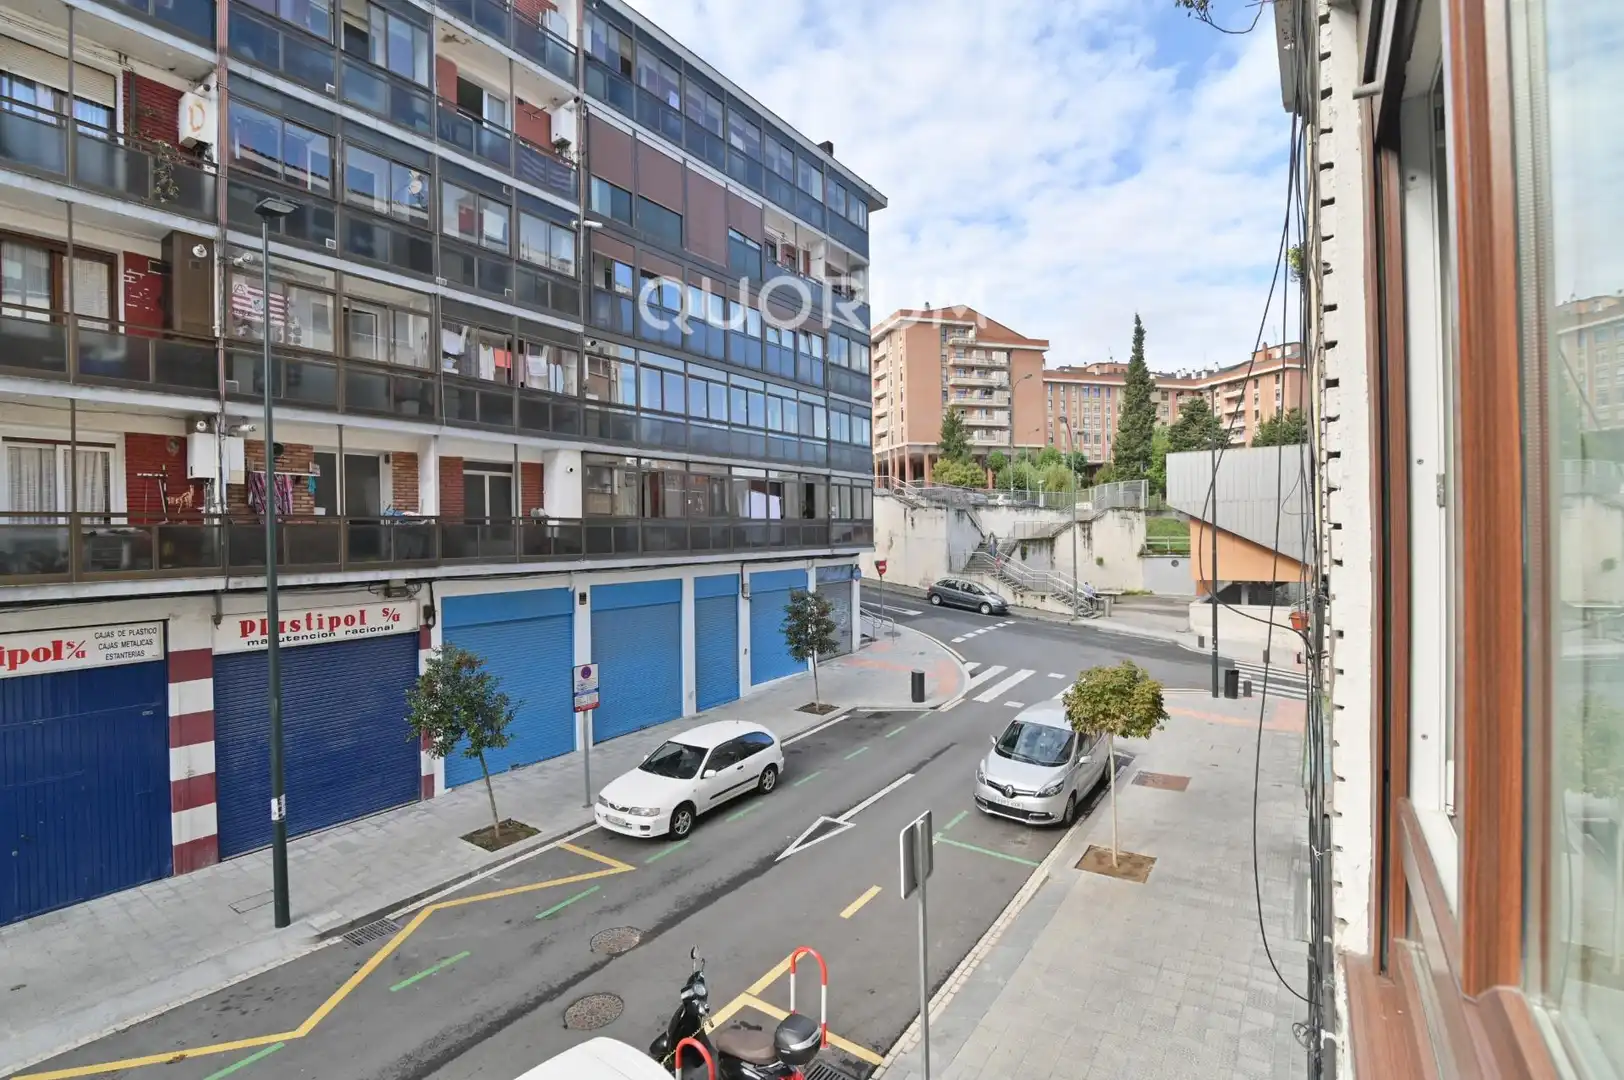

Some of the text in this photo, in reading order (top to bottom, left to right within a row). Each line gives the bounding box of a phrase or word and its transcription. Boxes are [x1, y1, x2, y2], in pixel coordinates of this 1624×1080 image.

[94, 627, 158, 639] CAJAS DE PLASTICO
[247, 624, 394, 646] mautencion racional
[98, 638, 154, 650] CAJAS METALICAS
[105, 649, 145, 660] ESTANTERIAS
